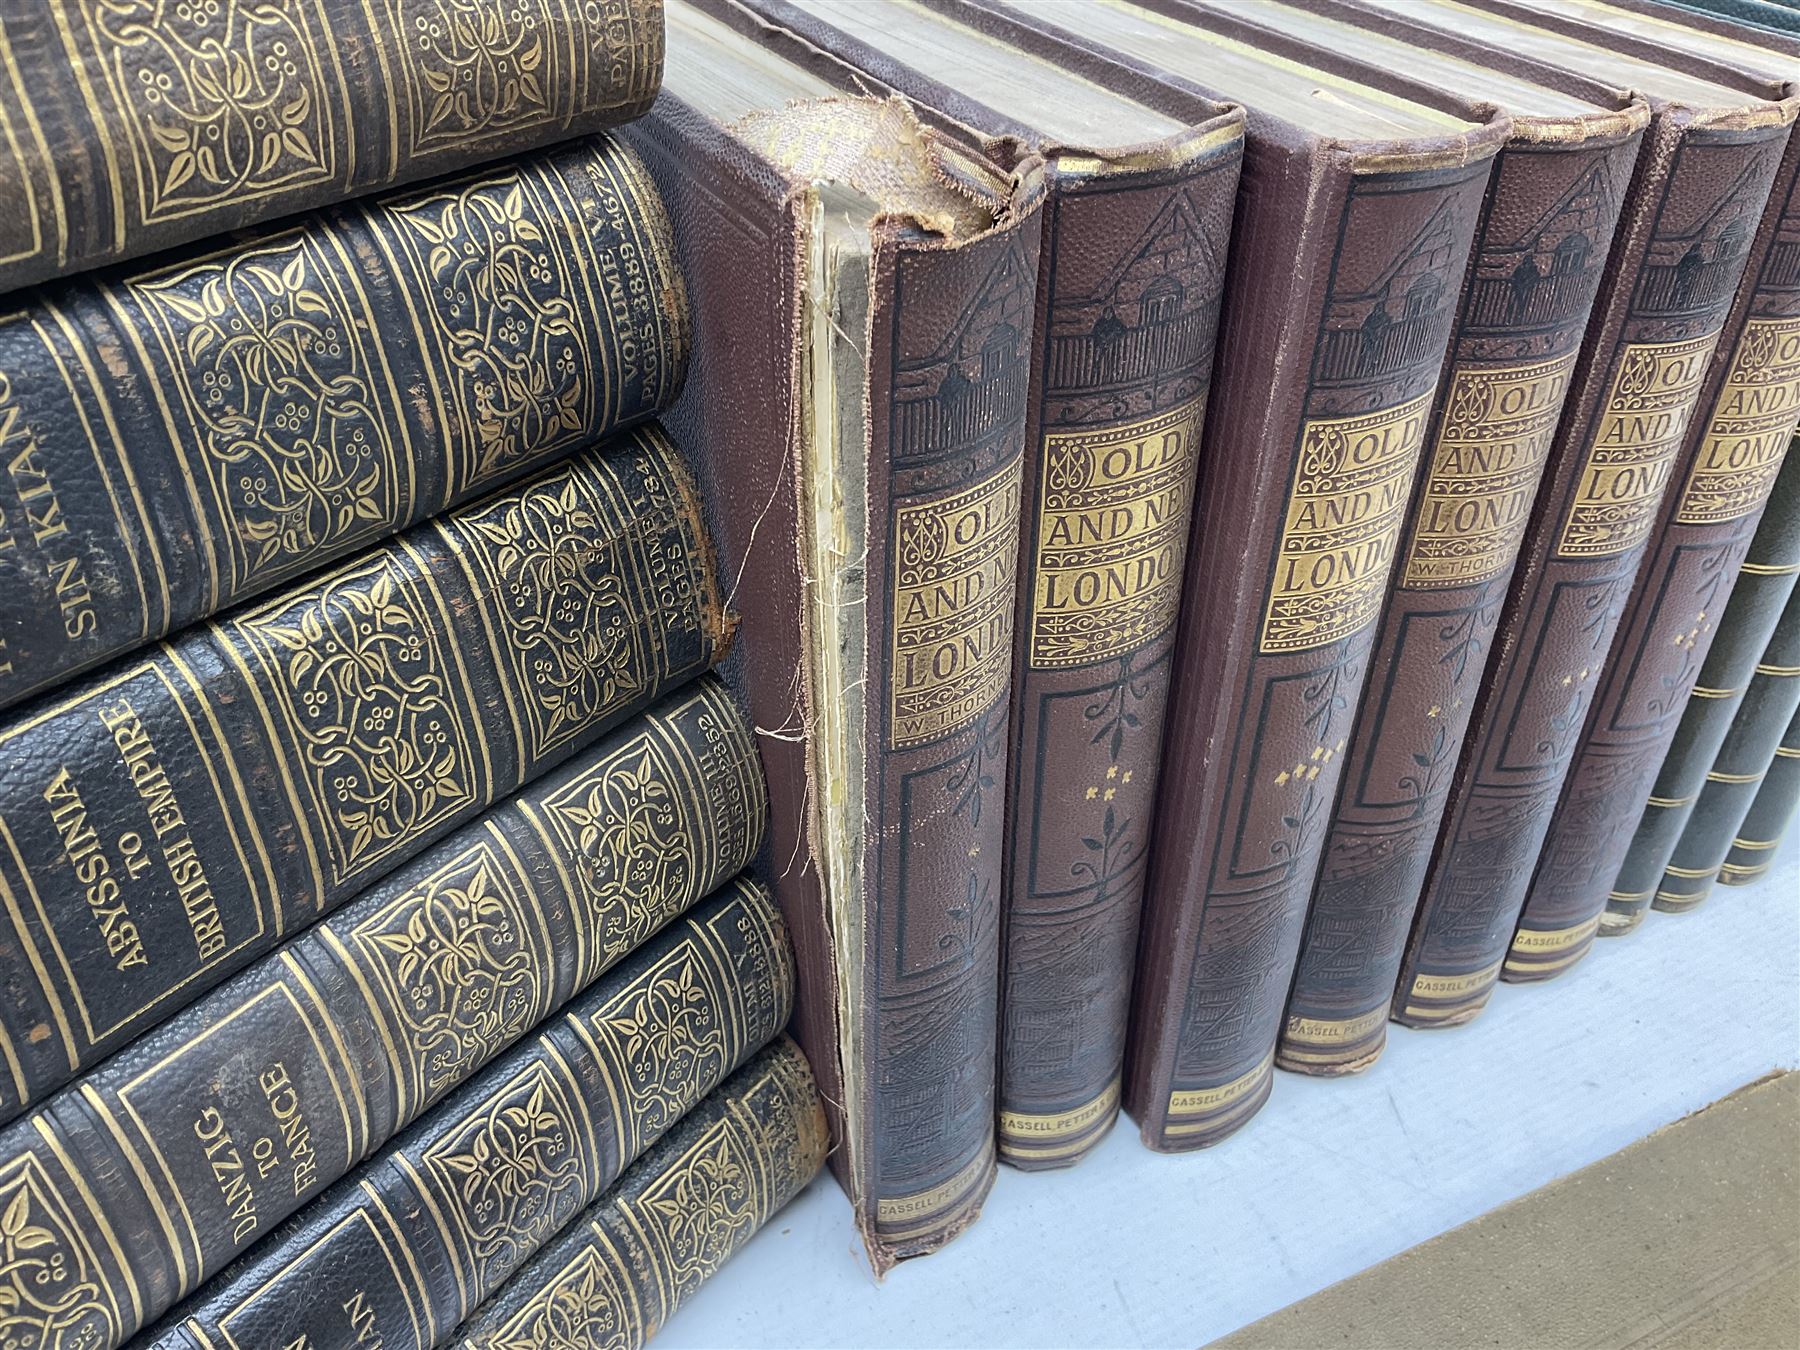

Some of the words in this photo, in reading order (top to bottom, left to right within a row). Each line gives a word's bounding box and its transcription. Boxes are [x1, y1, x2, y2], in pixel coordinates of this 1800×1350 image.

[581, 198, 604, 238] VI
[586, 161, 649, 313] 3889-4672
[600, 247, 639, 383] VOLUME
[640, 322, 658, 407] PAGES
[1499, 374, 1565, 417] OLD
[1721, 386, 1787, 415] AND
[1101, 430, 1182, 480] OLD
[1352, 416, 1420, 465] OLD
[1437, 442, 1516, 475] AND
[1601, 413, 1672, 445] AND
[954, 480, 1020, 546] OLD
[1045, 507, 1134, 547] AND
[1290, 491, 1372, 531] AND
[1377, 466, 1412, 514] NE
[48, 556, 97, 641] SIN
[642, 517, 678, 629] VOLUME
[667, 542, 698, 634] PAGES
[902, 571, 985, 625] AND
[98, 698, 187, 840] EMPIRE
[118, 831, 152, 881] TO
[711, 781, 731, 874] VOLUME
[43, 764, 148, 972] ABYSSINIA
[163, 831, 226, 963] BRITISH
[1416, 980, 1464, 992] CASSELL
[1172, 1092, 1221, 1107] CASSELL
[253, 1137, 280, 1179] TO
[259, 1061, 317, 1198] FRANCE
[194, 1106, 258, 1245] DANZIG
[879, 1198, 933, 1215] CASSELL
